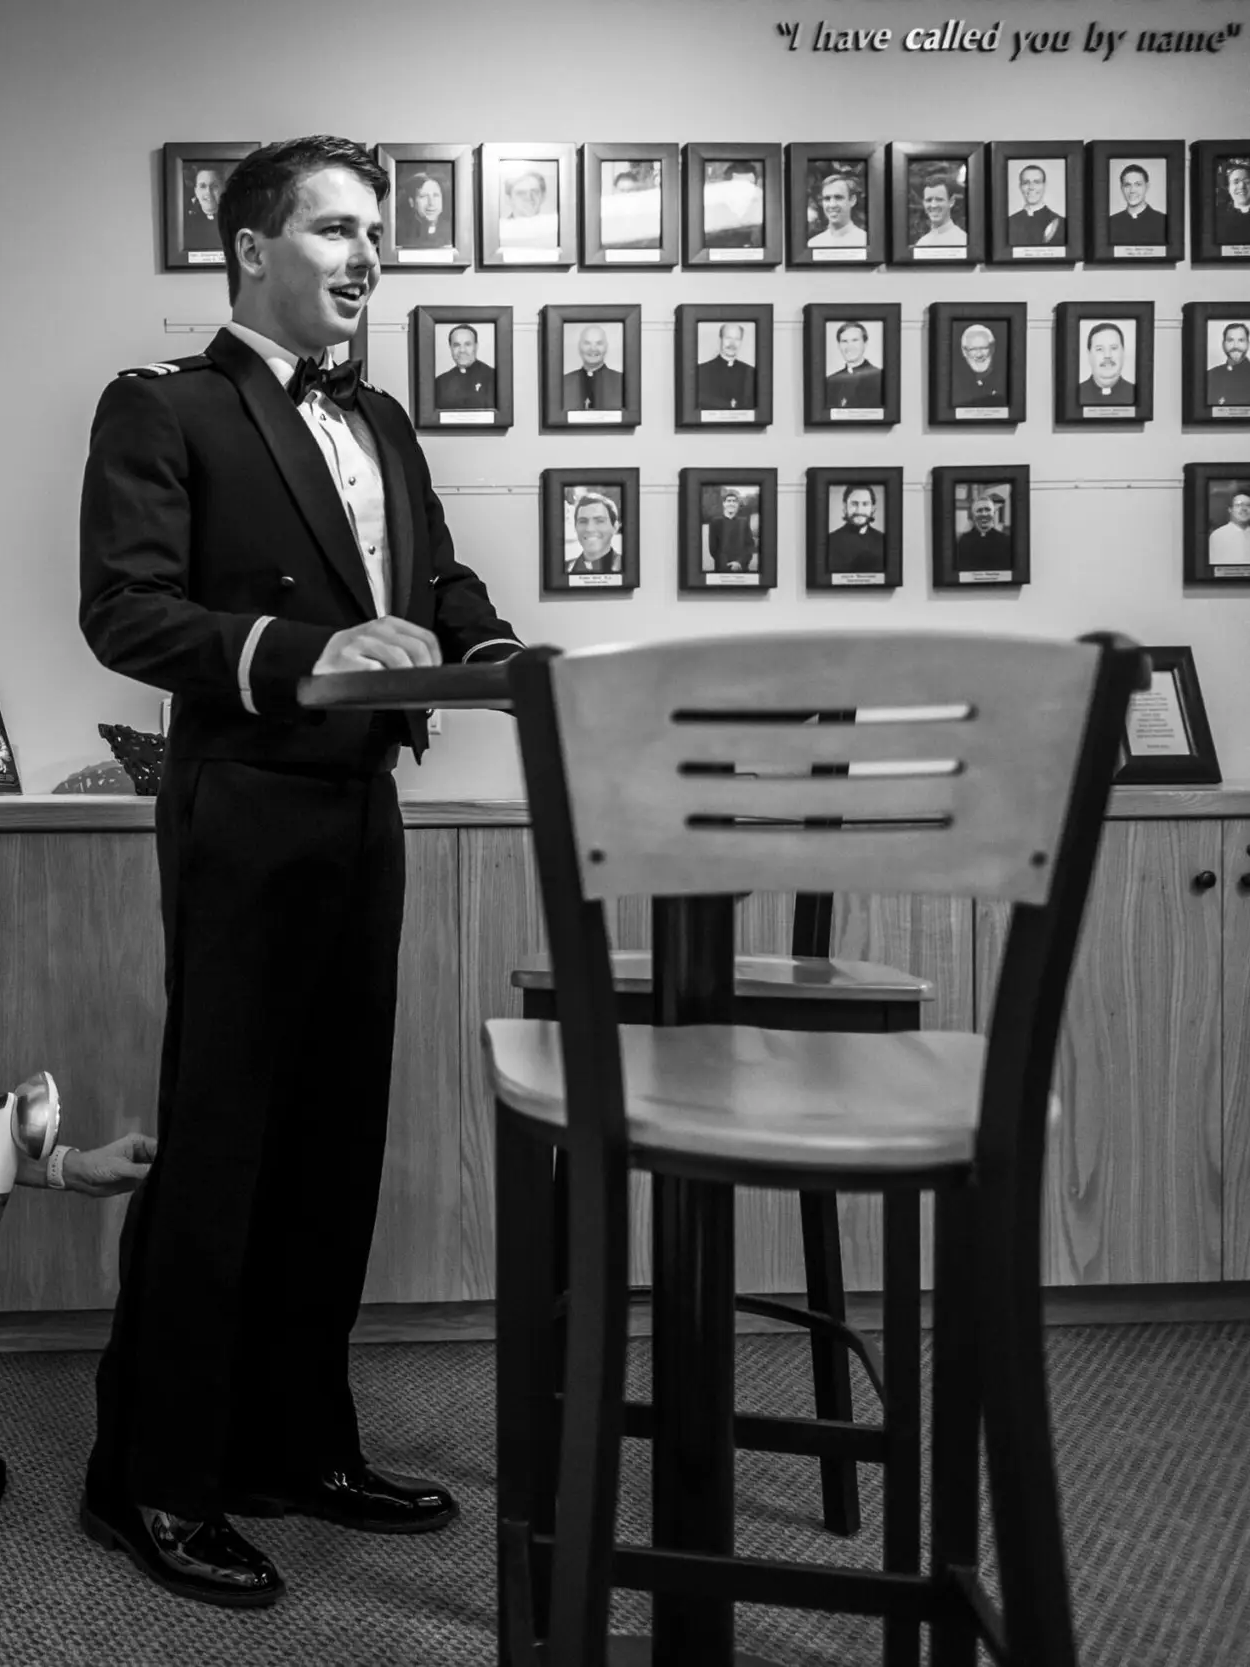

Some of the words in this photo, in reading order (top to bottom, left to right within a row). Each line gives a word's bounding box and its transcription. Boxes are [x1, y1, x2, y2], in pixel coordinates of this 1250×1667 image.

[813, 19, 893, 52] have
[904, 18, 1006, 52] called
[1008, 30, 1071, 62] you
[1082, 20, 1128, 62] by
